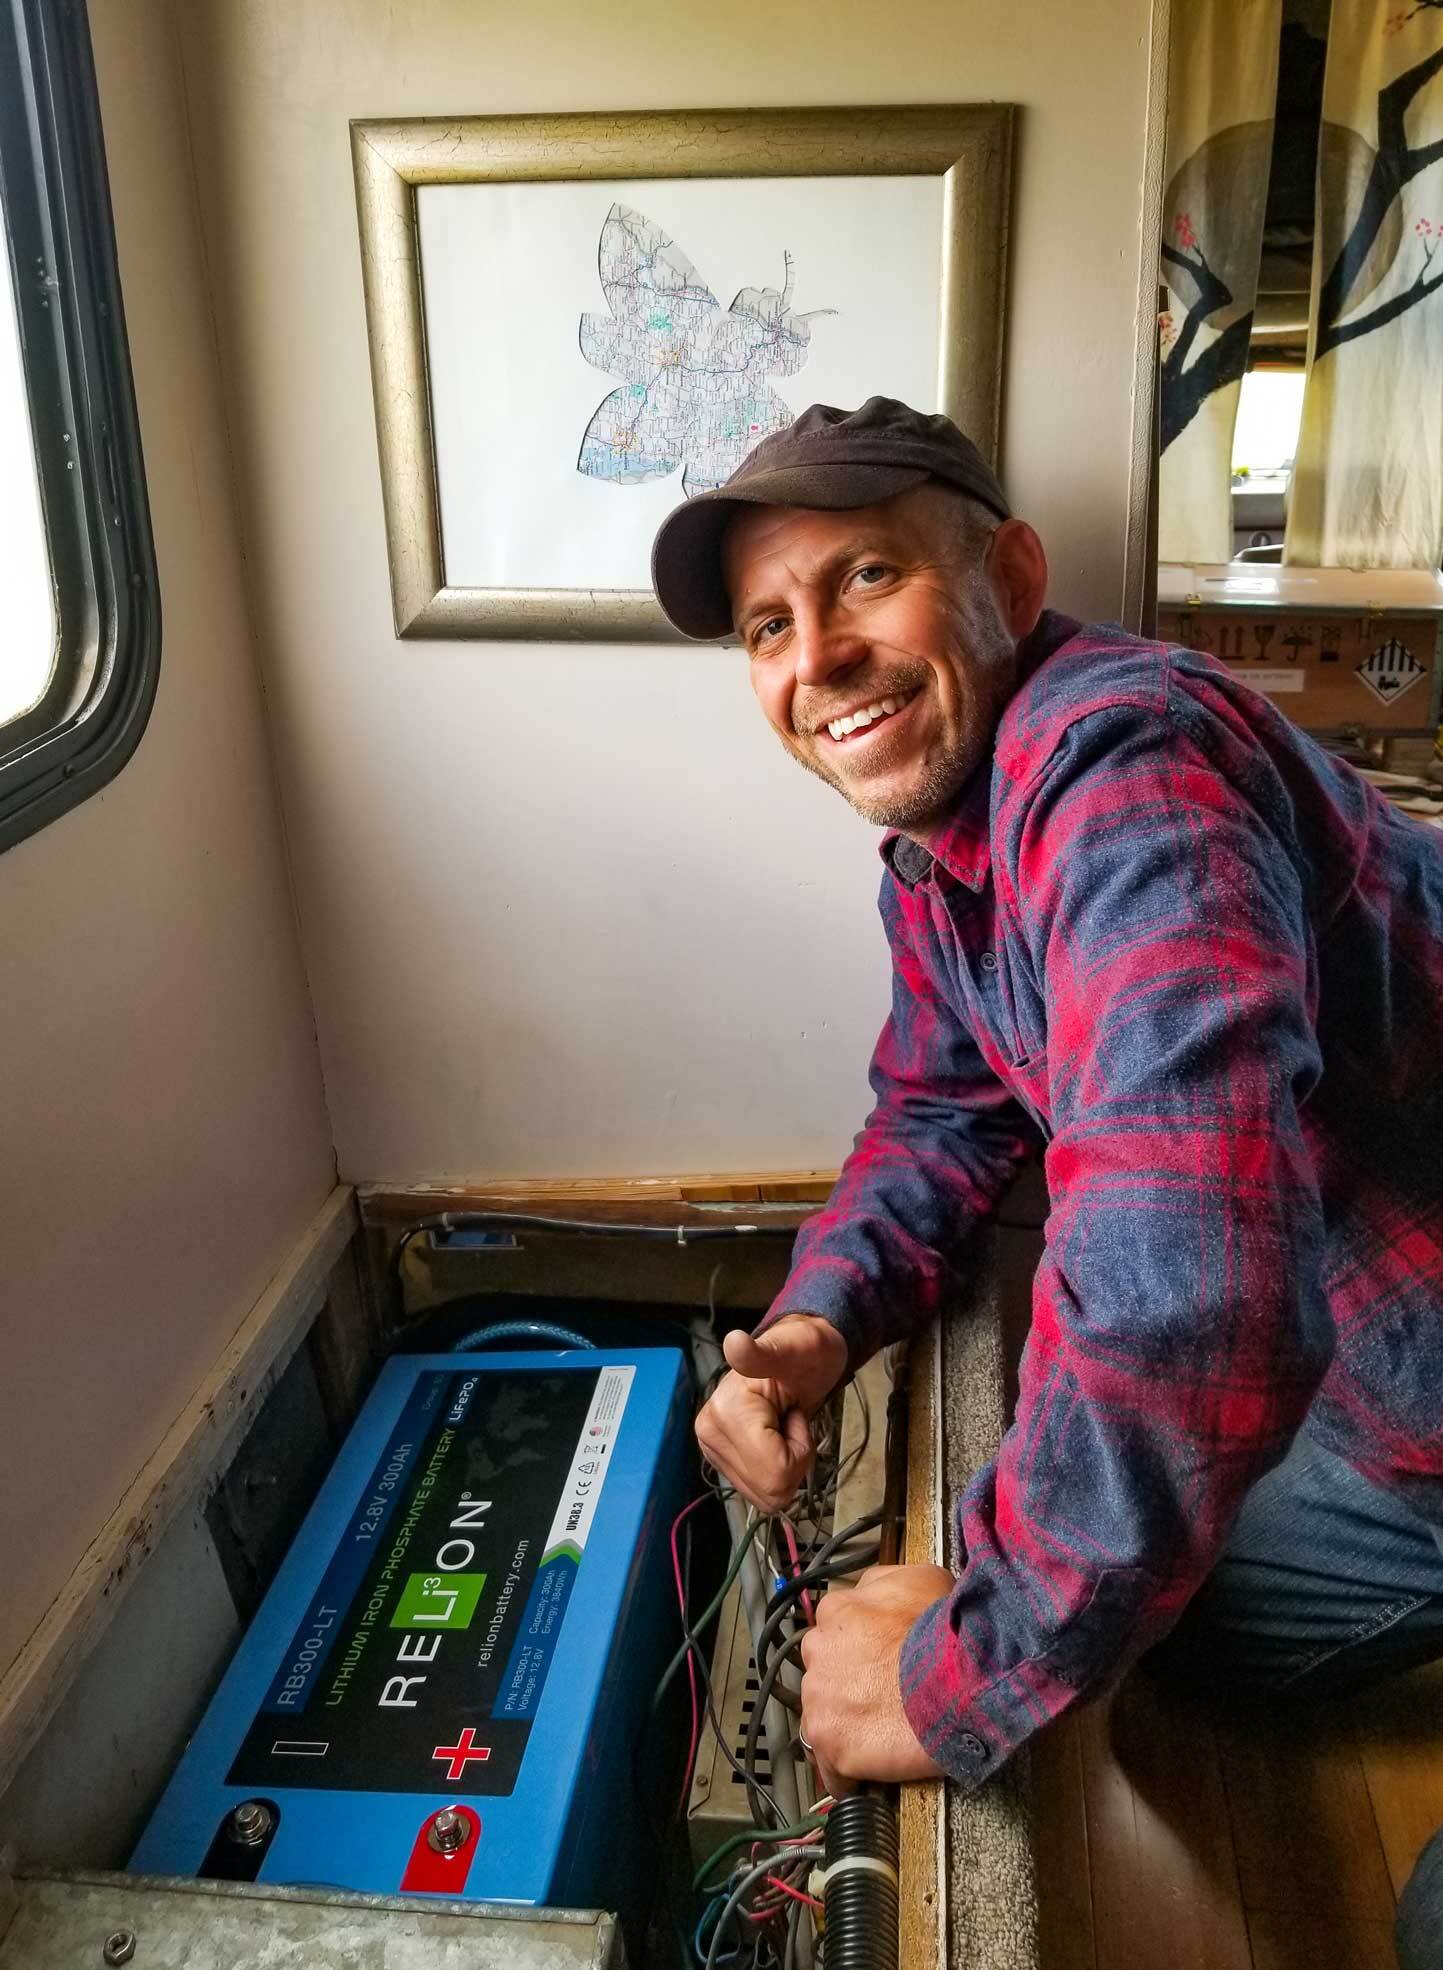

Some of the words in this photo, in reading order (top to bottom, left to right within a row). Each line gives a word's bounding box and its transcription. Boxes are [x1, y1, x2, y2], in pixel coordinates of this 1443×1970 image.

[566, 1502, 584, 1531] UN38.3
[277, 1605, 337, 1704] RB300-LT
[355, 1496, 388, 1542] 12.8V
[378, 1443, 413, 1491] 300Ah
[325, 1631, 370, 1706] LITHIUM
[361, 1583, 390, 1627] IRON
[381, 1490, 431, 1580] PHOSPHATE
[422, 1428, 456, 1487] BATTERY
[478, 1539, 529, 1667] relionbattery.com
[512, 1645, 533, 1688] RB300-LT
[517, 1675, 537, 1710] Voltage:
